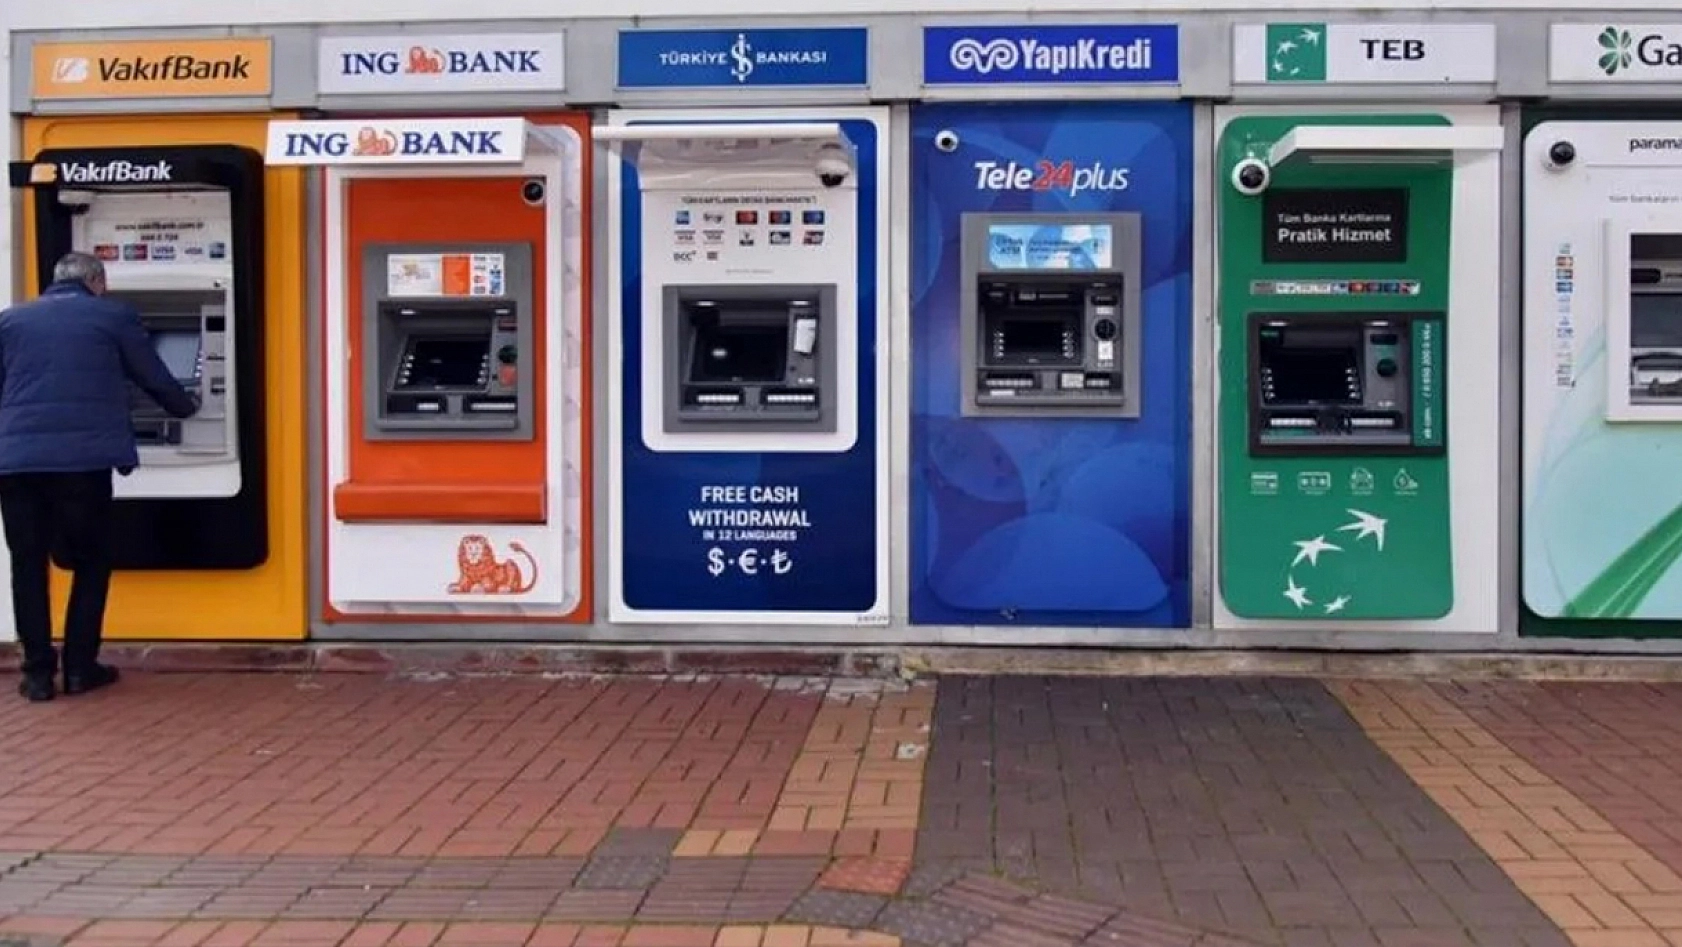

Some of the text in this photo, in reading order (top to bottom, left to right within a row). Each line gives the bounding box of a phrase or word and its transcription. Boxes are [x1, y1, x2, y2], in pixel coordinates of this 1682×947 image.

[659, 51, 727, 65] TÜRKİYE
[756, 51, 827, 63] BANKASI
[1020, 39, 1151, 74] YapıKredi
[1359, 39, 1425, 60] TEB
[1638, 34, 1682, 66] Ga
[98, 54, 250, 81] VakıfBank
[341, 50, 541, 75] ING BANK
[285, 131, 502, 156] ING BANK
[61, 160, 172, 182] VakıfBank
[1278, 227, 1392, 243] Pratik Hizmet
[701, 486, 799, 502] FREE CASH
[689, 509, 811, 527] WITHDRAWAL
[703, 531, 797, 541] IN 12 LANGUAGES
